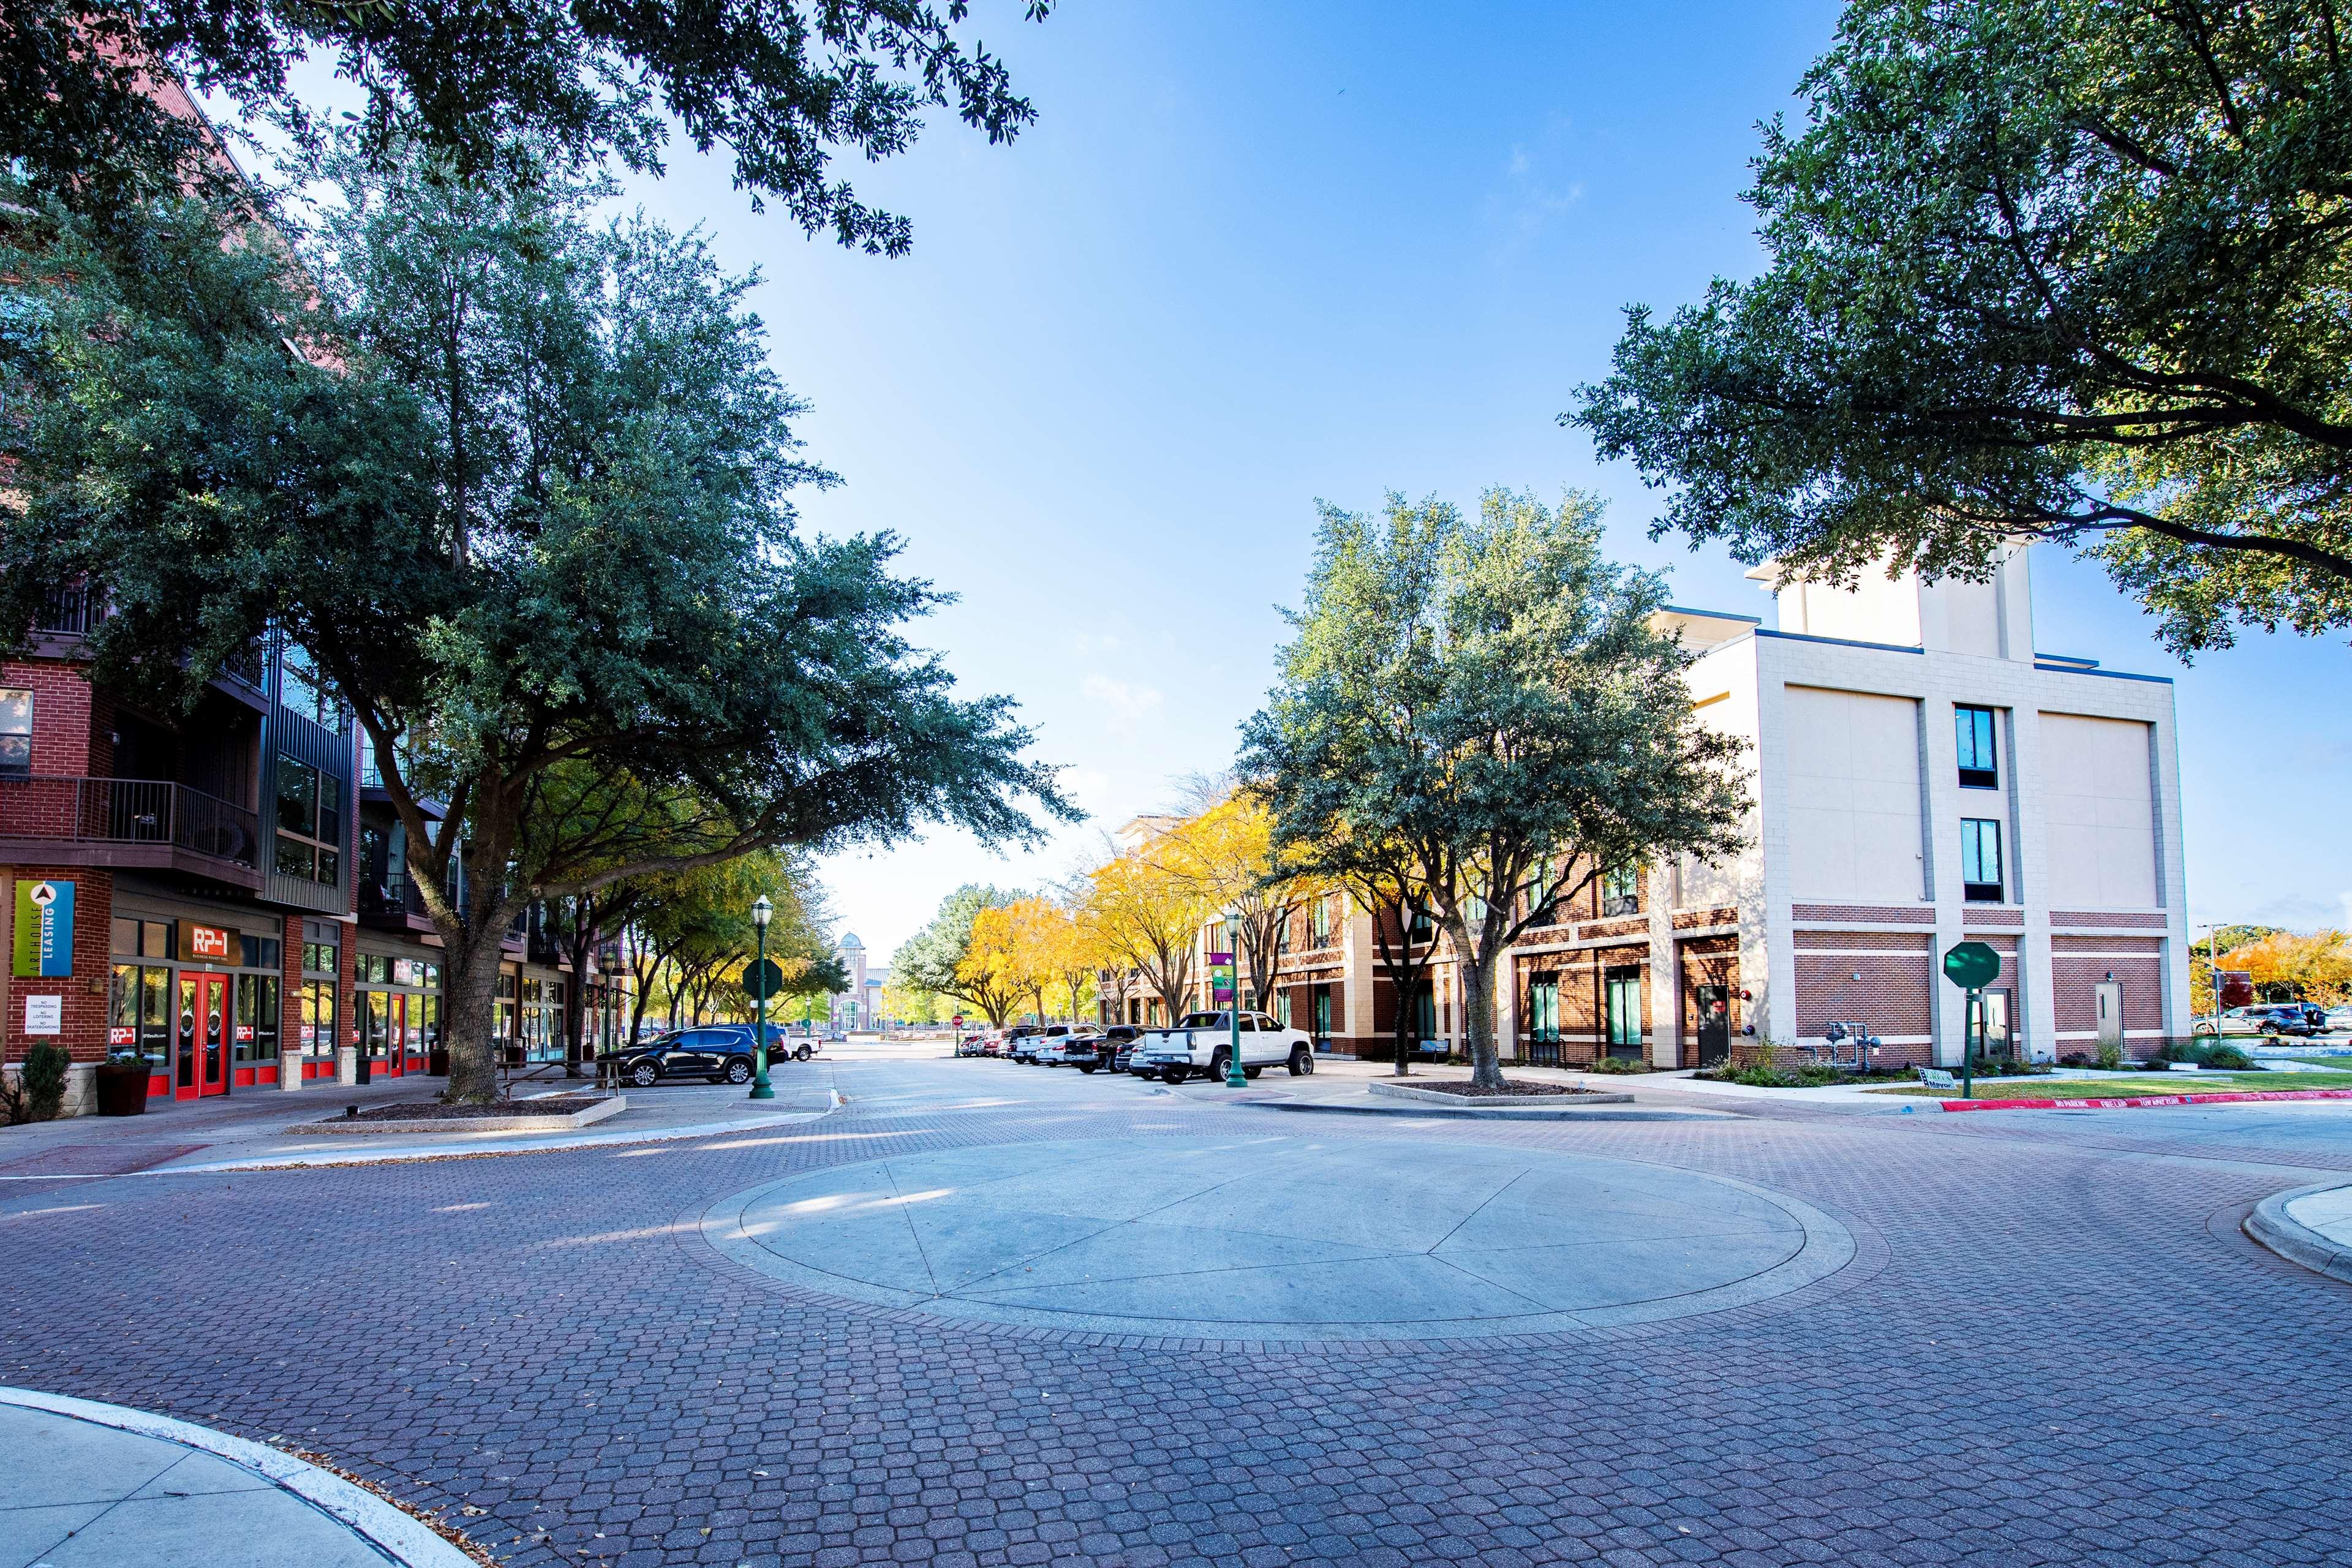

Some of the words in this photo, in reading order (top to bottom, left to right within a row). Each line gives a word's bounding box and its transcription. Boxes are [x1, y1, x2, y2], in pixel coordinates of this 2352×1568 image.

[29, 907, 42, 971] ARTHOUSE
[43, 908, 54, 959] LEASING
[194, 928, 227, 954] RP-1
[111, 1028, 136, 1043] RP-1
[237, 1027, 254, 1039] RP-1
